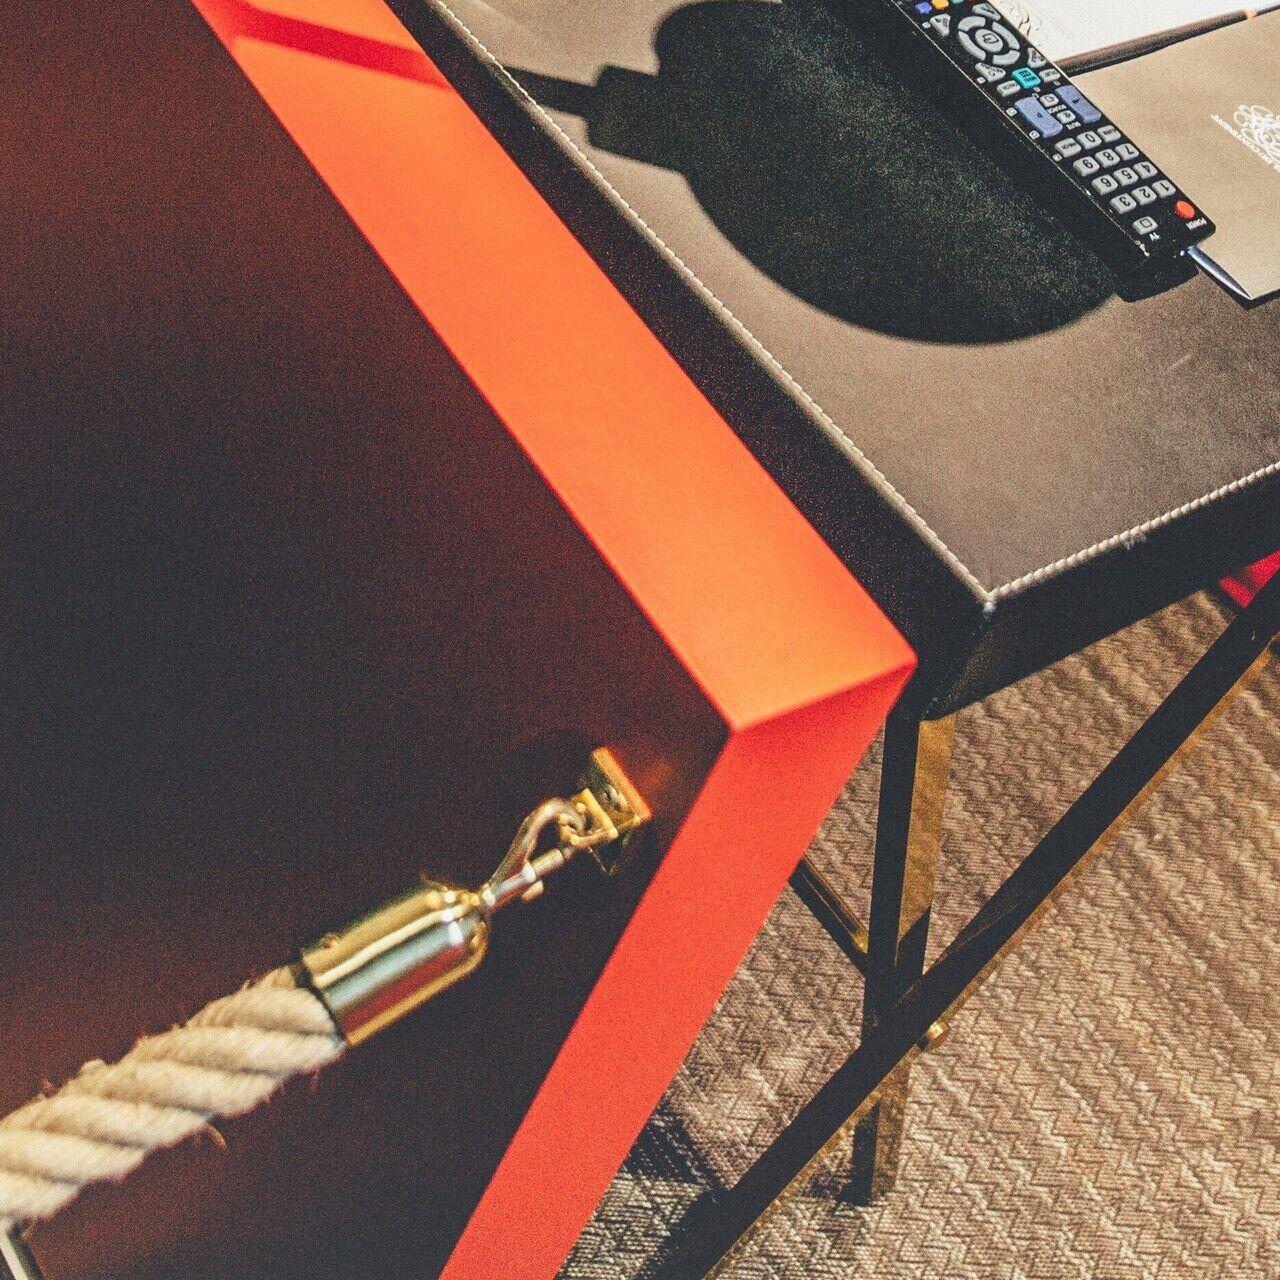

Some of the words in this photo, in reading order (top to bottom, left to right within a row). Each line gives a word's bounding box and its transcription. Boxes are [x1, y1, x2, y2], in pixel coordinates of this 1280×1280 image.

[1085, 133, 1095, 142] 0
[1124, 145, 1135, 155] 7
[1102, 151, 1114, 161] 8
[1082, 158, 1094, 169] 9
[1141, 163, 1151, 173] 4
[1121, 169, 1133, 180] 5
[1100, 177, 1112, 188] 6
[1160, 182, 1170, 192] 1
[1139, 188, 1151, 199] 2
[1119, 196, 1131, 207] 3
[1149, 232, 1160, 241] TV
